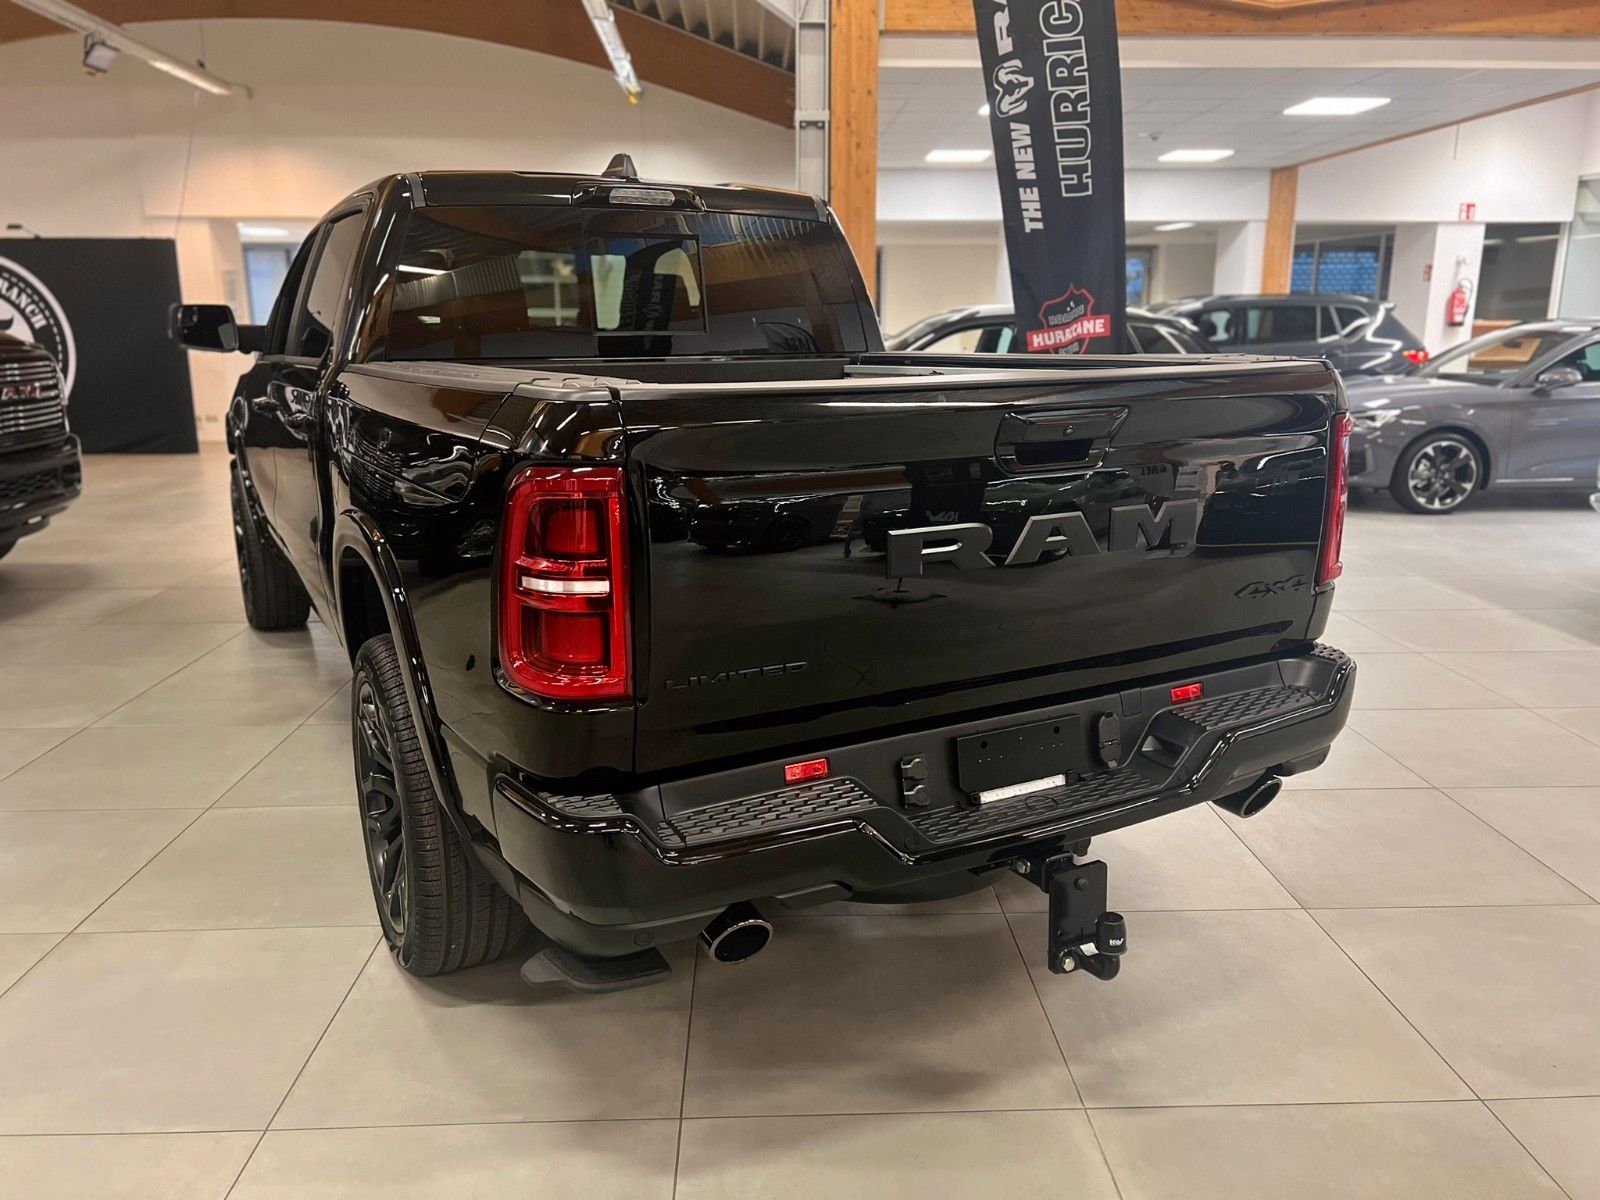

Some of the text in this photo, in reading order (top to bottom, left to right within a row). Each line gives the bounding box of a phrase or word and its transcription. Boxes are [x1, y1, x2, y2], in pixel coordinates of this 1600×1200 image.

[993, 0, 1045, 233] THE NEW R
[1038, 0, 1093, 198] HURRIC
[887, 499, 1200, 579] RAM
[663, 661, 808, 693] LIMITED
